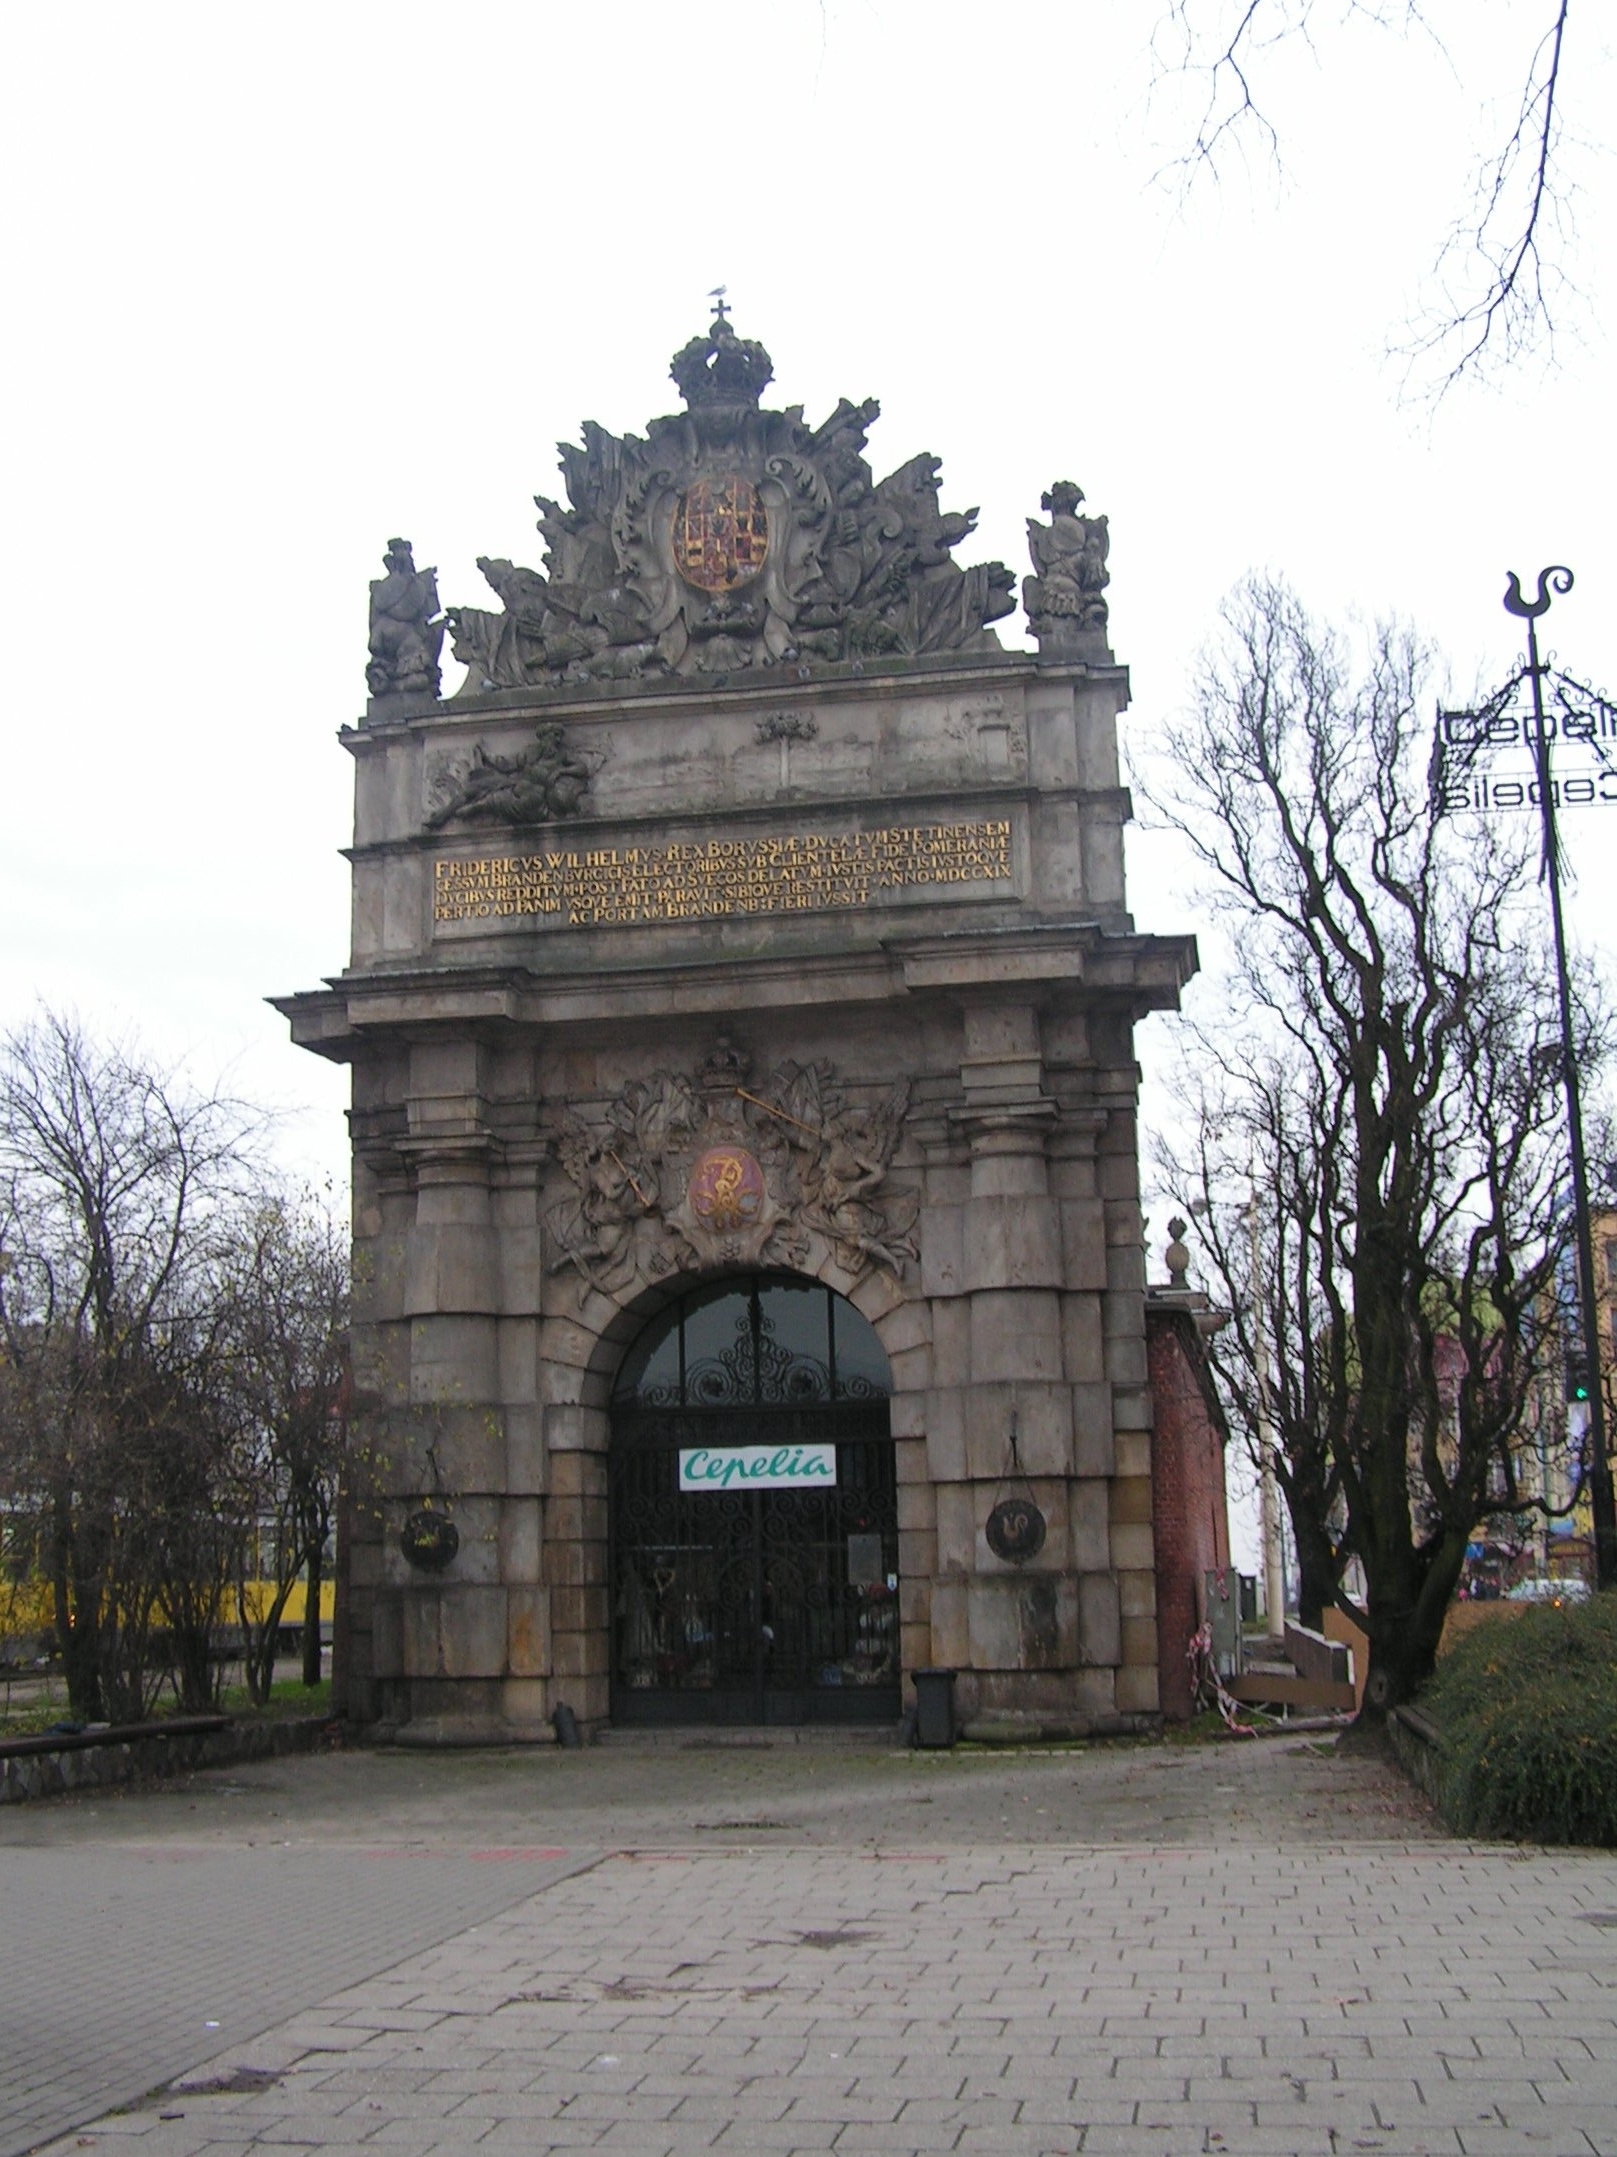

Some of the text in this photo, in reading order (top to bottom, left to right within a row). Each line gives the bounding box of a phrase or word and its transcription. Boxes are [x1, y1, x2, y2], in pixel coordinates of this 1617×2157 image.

[435, 856, 542, 878] FRIDERICVS
[667, 843, 704, 860] REX
[871, 843, 908, 858] FIDE
[493, 902, 514, 915] AD
[880, 871, 930, 887] ANNO
[621, 877, 660, 893] FATO
[663, 875, 685, 889] AD
[569, 909, 590, 924] AC
[684, 1449, 833, 1486] Cepelia
